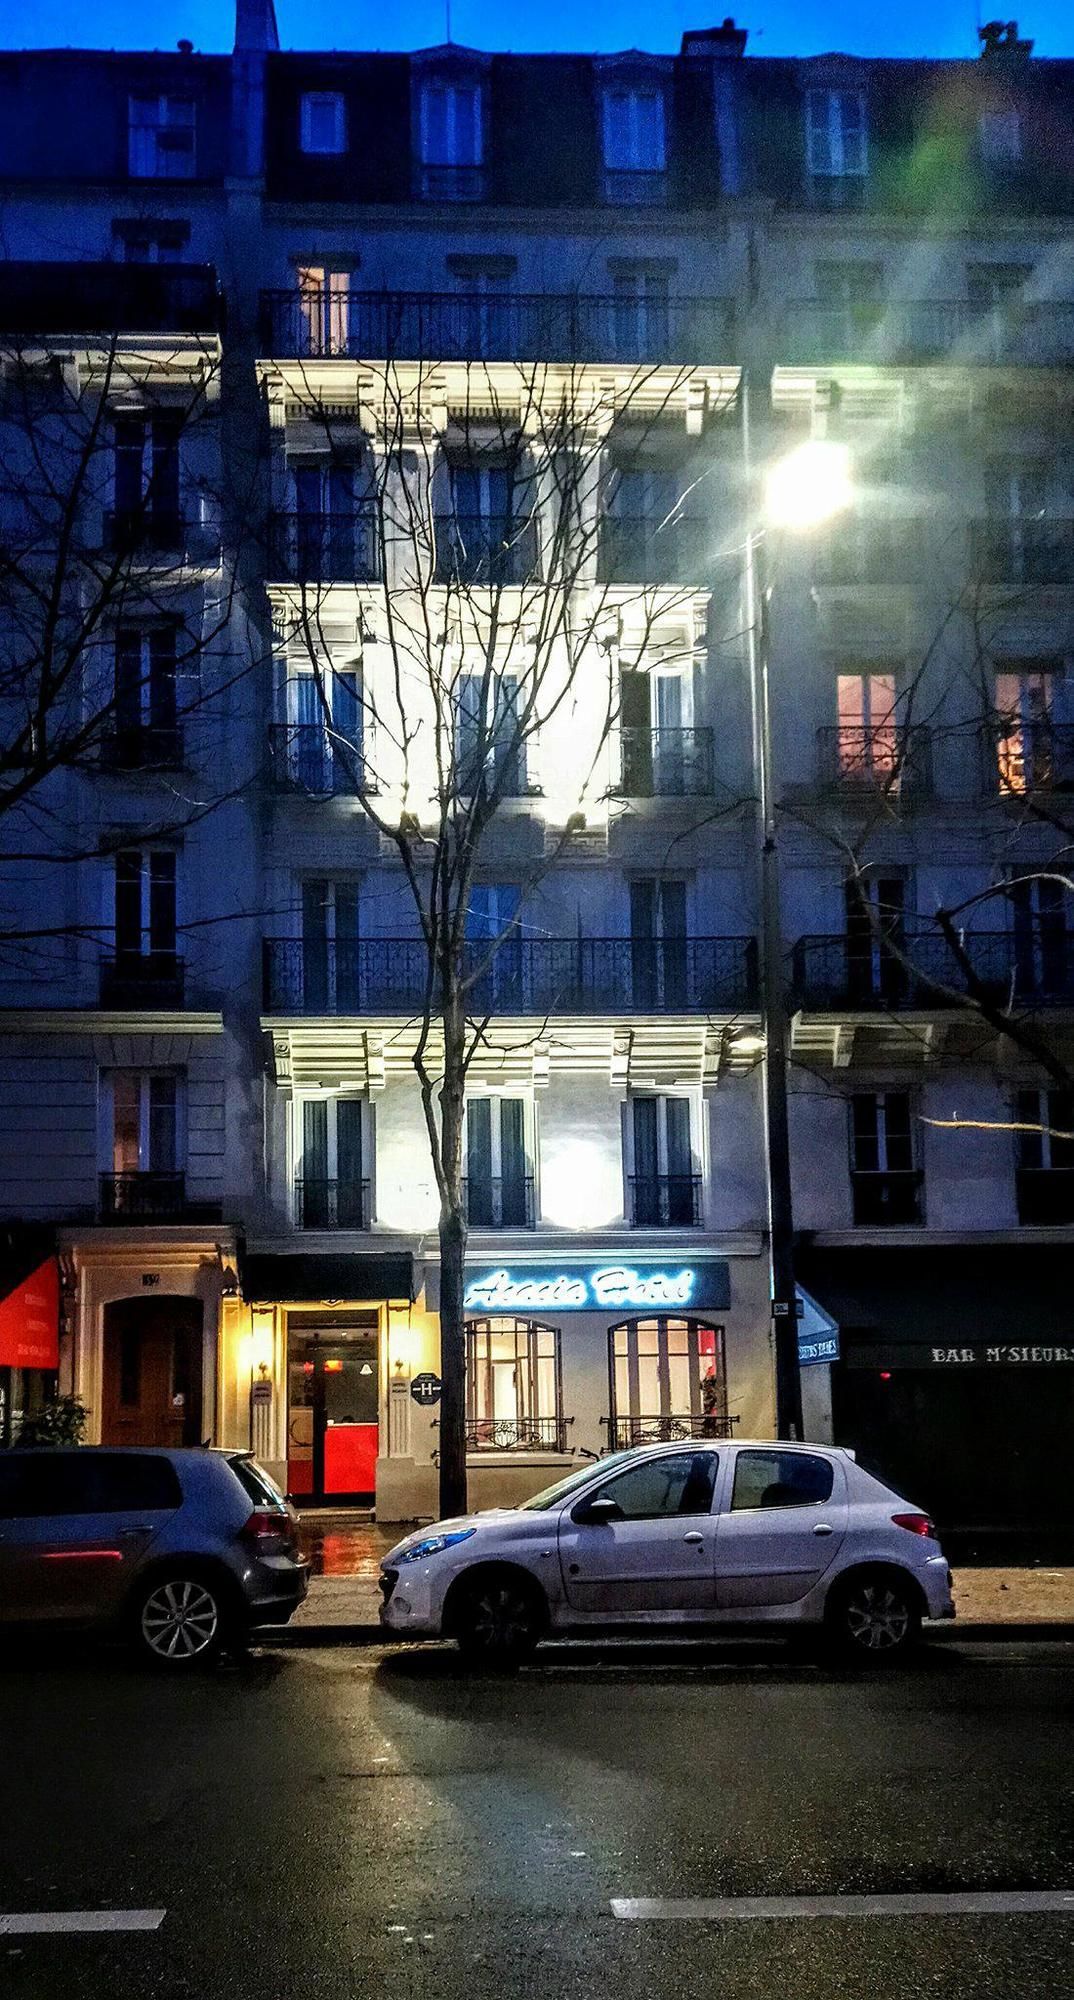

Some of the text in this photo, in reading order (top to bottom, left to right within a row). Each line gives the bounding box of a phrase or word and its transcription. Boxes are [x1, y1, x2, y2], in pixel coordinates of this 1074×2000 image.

[464, 1270, 588, 1305] Acacia
[932, 1347, 976, 1363] BAR
[421, 1382, 432, 1396] H
